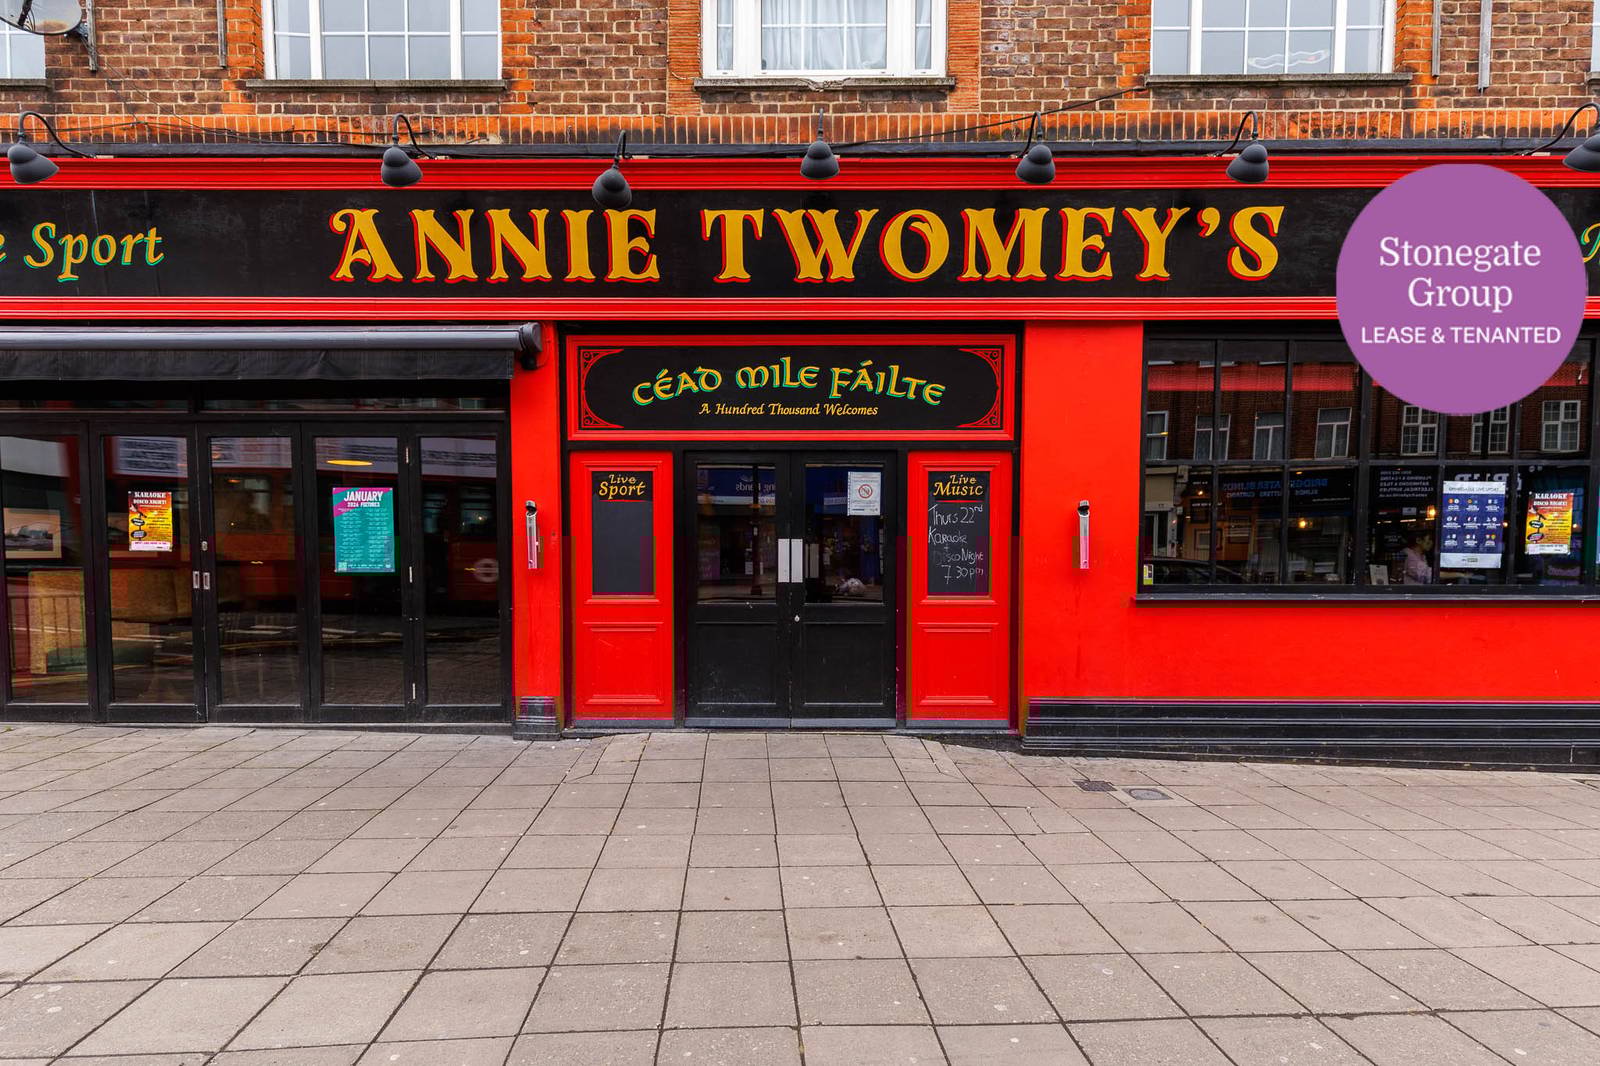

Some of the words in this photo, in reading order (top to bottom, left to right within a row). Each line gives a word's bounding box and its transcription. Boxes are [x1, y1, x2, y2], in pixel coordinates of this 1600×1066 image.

[23, 222, 165, 283] Sport
[328, 208, 661, 284] ANNIE
[699, 204, 1286, 284] TWOMEY'S
[829, 359, 946, 406] FÁILTE
[699, 403, 711, 416] A
[715, 403, 765, 416] Hundred
[768, 402, 822, 416] Thousand
[823, 403, 879, 416] Welcomes
[608, 473, 637, 485] Live
[949, 474, 977, 485] Live
[343, 491, 384, 502] JANUARY
[598, 481, 647, 500] Sport
[933, 481, 984, 496] Music
[928, 526, 967, 545] Karaoke
[961, 547, 984, 565] Night
